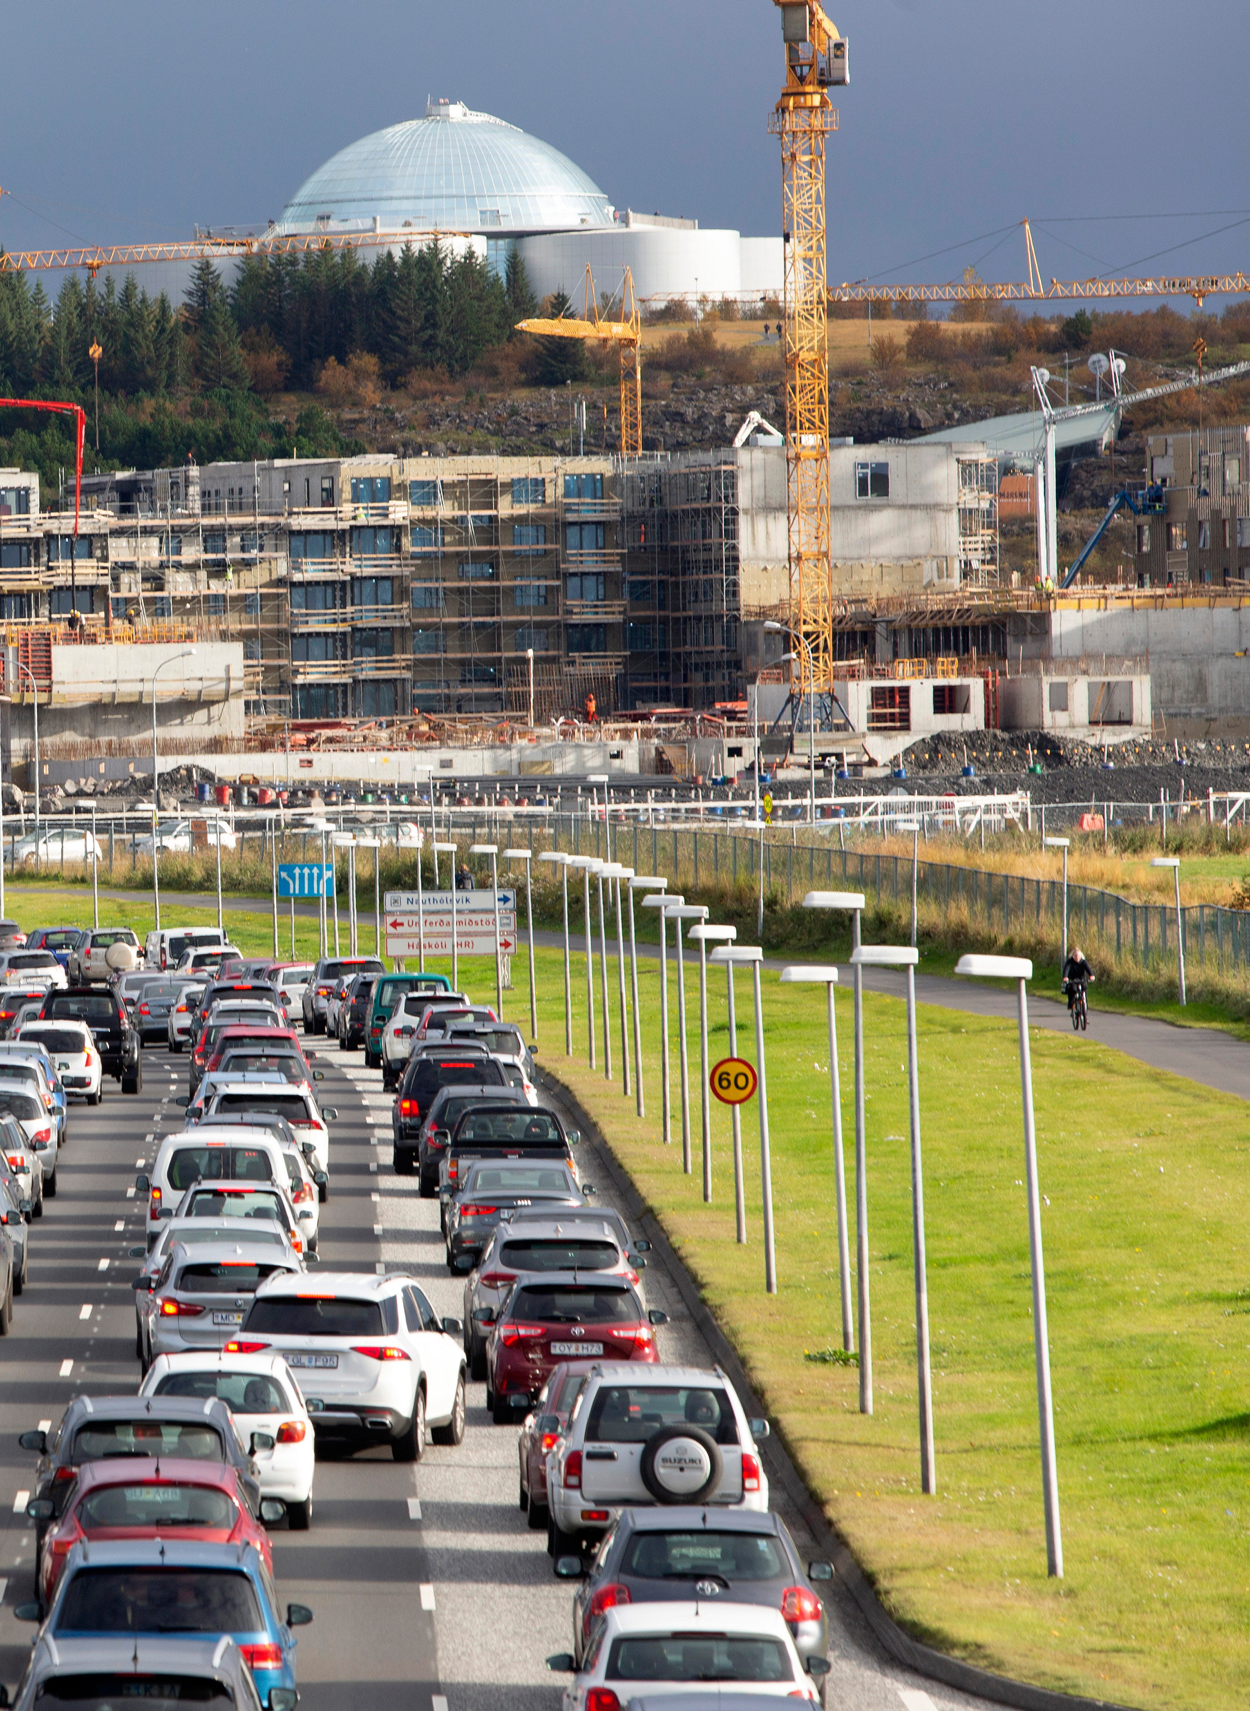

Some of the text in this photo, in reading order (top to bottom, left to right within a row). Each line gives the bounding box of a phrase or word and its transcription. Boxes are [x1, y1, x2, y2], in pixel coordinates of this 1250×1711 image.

[455, 941, 475, 949] HR)
[718, 1071, 749, 1091] 60
[661, 1456, 702, 1465] SUZUKI
